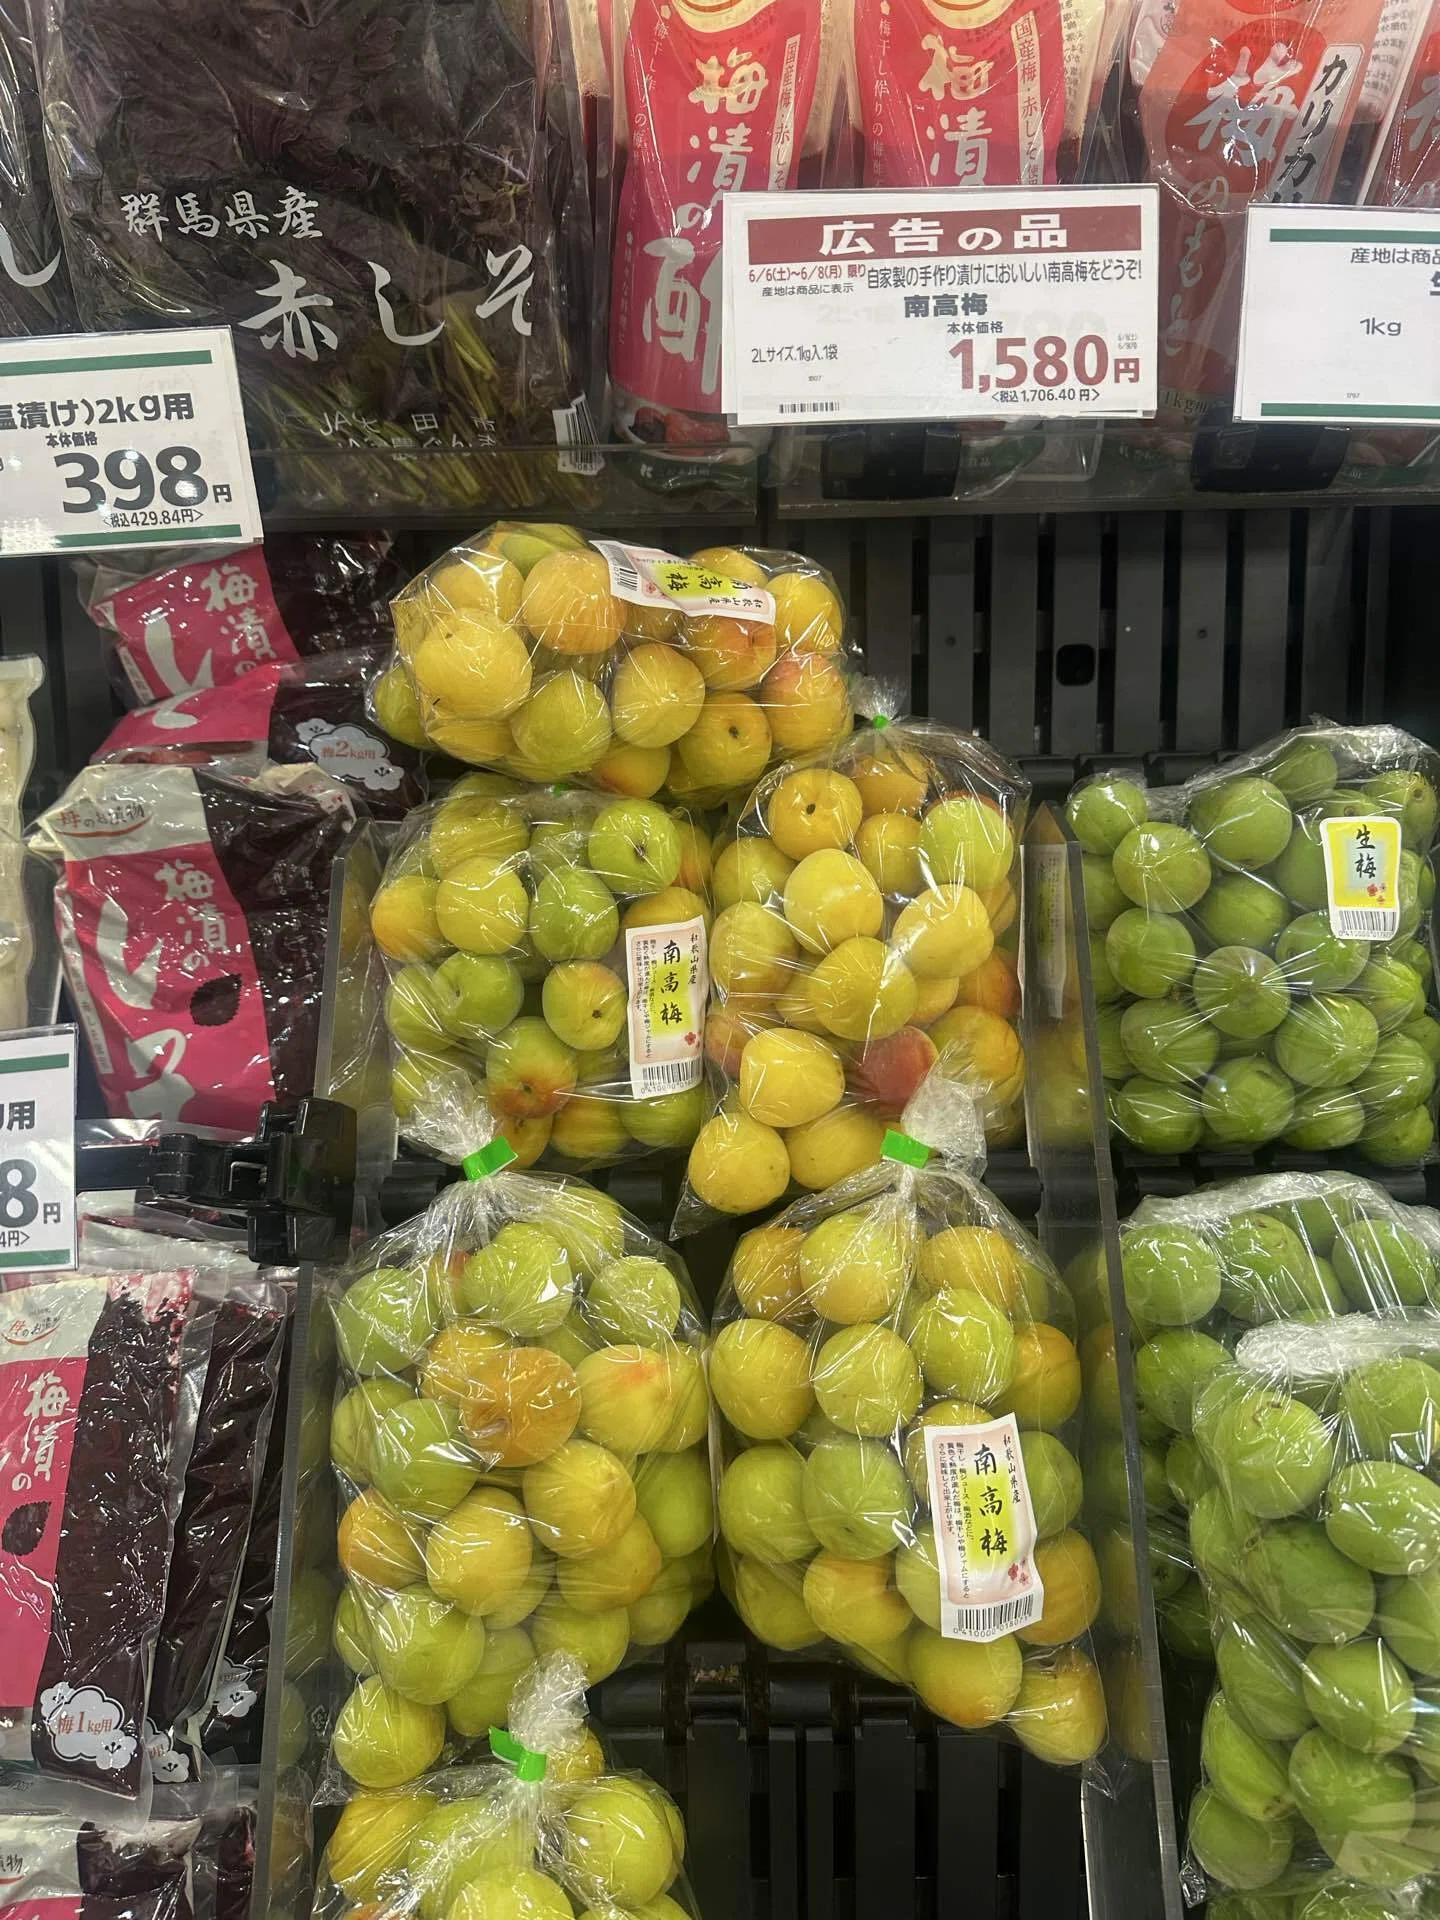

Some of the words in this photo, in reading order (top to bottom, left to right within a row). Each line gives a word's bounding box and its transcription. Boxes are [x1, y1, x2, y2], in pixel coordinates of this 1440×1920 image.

[1271, 54, 1348, 204] カリカ
[120, 185, 323, 243] 群馬県産
[819, 213, 1068, 256] 広告の品
[761, 282, 854, 297] 産地は商品に表示
[867, 259, 1142, 289] 自家製の手作り漬けに!おいしい南高梅をどうぞ!
[238, 244, 533, 361] 赤しそ
[904, 293, 988, 318] 南高梅
[947, 321, 1003, 335] 本体価格
[1359, 318, 1402, 336] 1kg
[46, 431, 98, 448] 本体価格
[1354, 824, 1377, 879] 生梅
[154, 859, 227, 970] 梅漬の
[660, 939, 683, 1026] 南高梅
[688, 932, 699, 985] 和歌山県産
[23, 1370, 71, 1491] 梅漬の
[1003, 1434, 1020, 1504] 和歌山県産
[973, 1444, 1008, 1557] 南高梅
